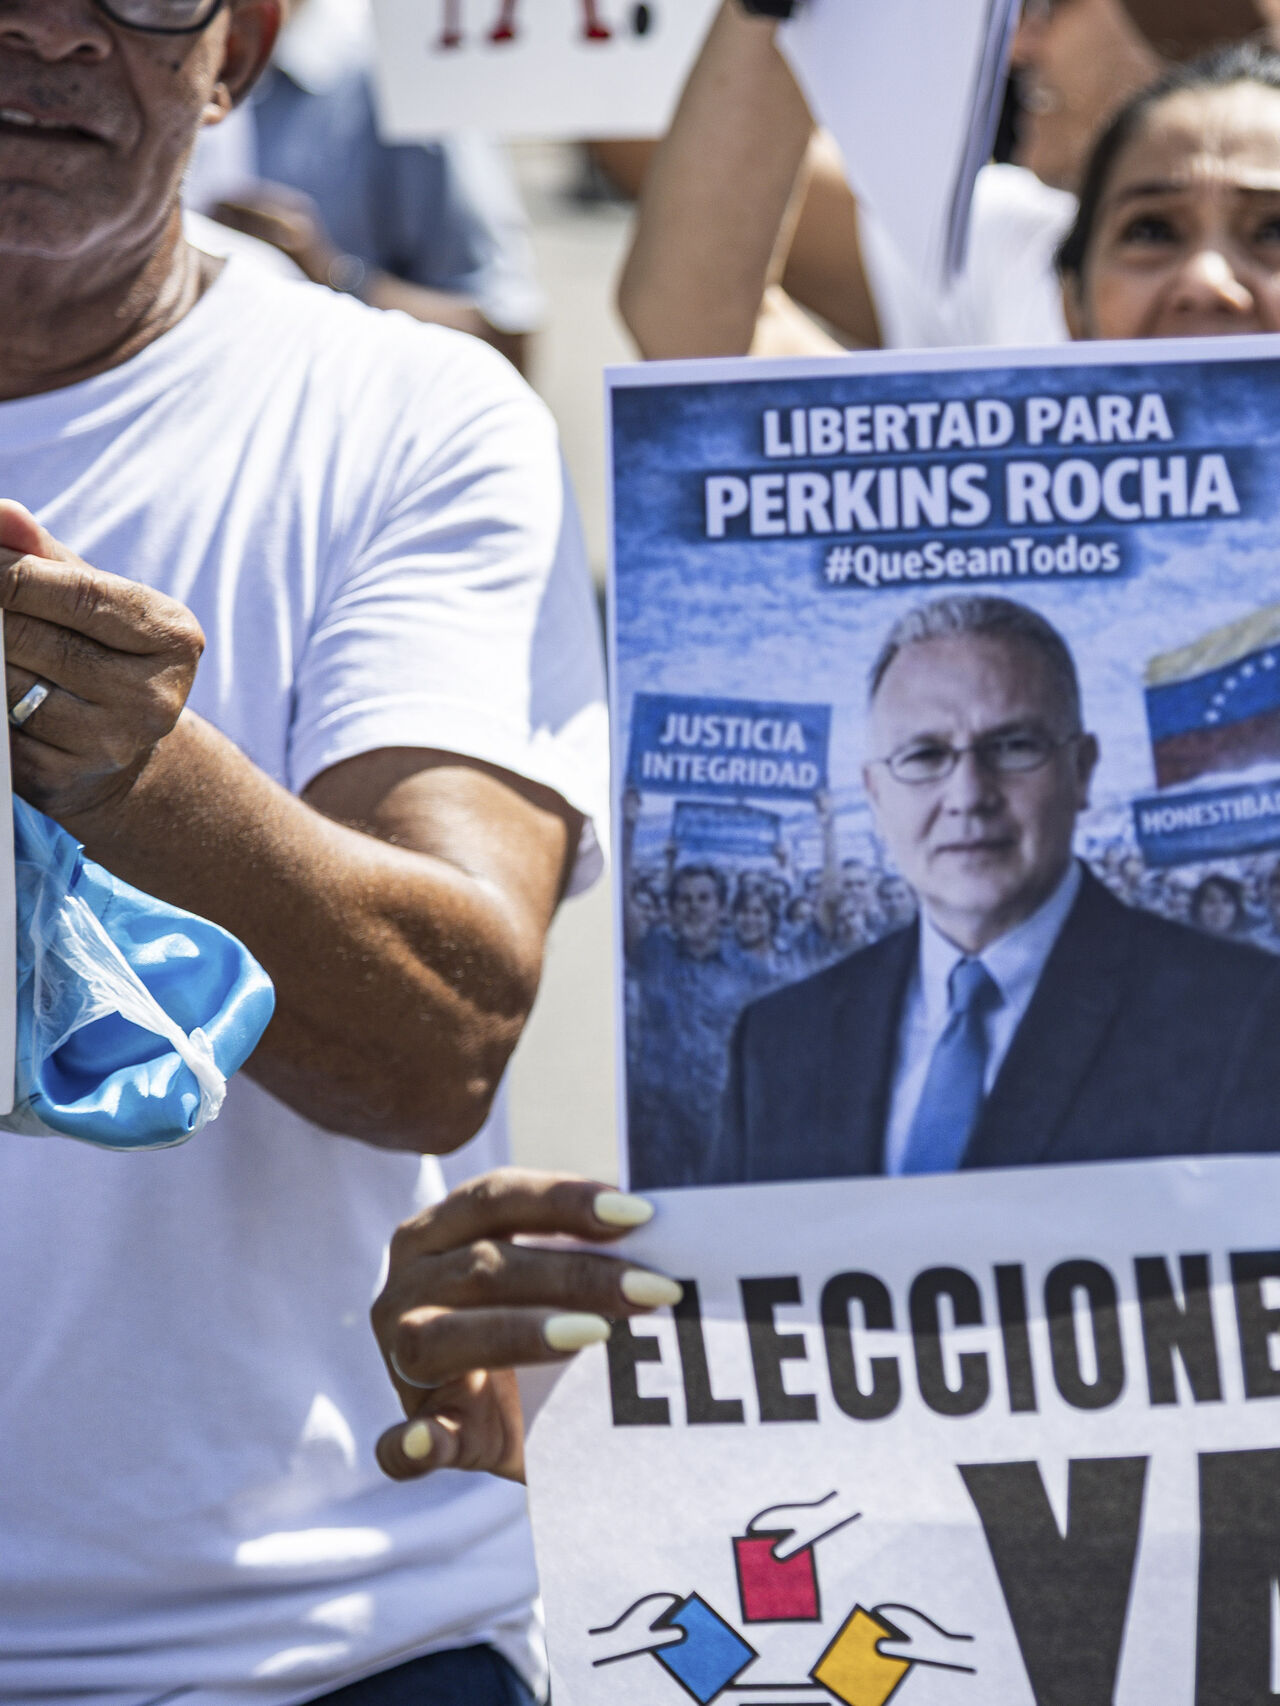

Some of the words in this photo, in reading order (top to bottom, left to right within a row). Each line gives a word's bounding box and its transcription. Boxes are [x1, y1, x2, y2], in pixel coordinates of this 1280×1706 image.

[763, 400, 1014, 458] LIBERTAD
[1027, 394, 1173, 444] PARA
[705, 464, 992, 537] PERKINS
[1007, 454, 1240, 524] ROCHA
[825, 536, 1121, 586] #QueSeanTodos
[658, 713, 807, 753] JUSTICIA
[642, 751, 819, 789] INTEGRIDAD
